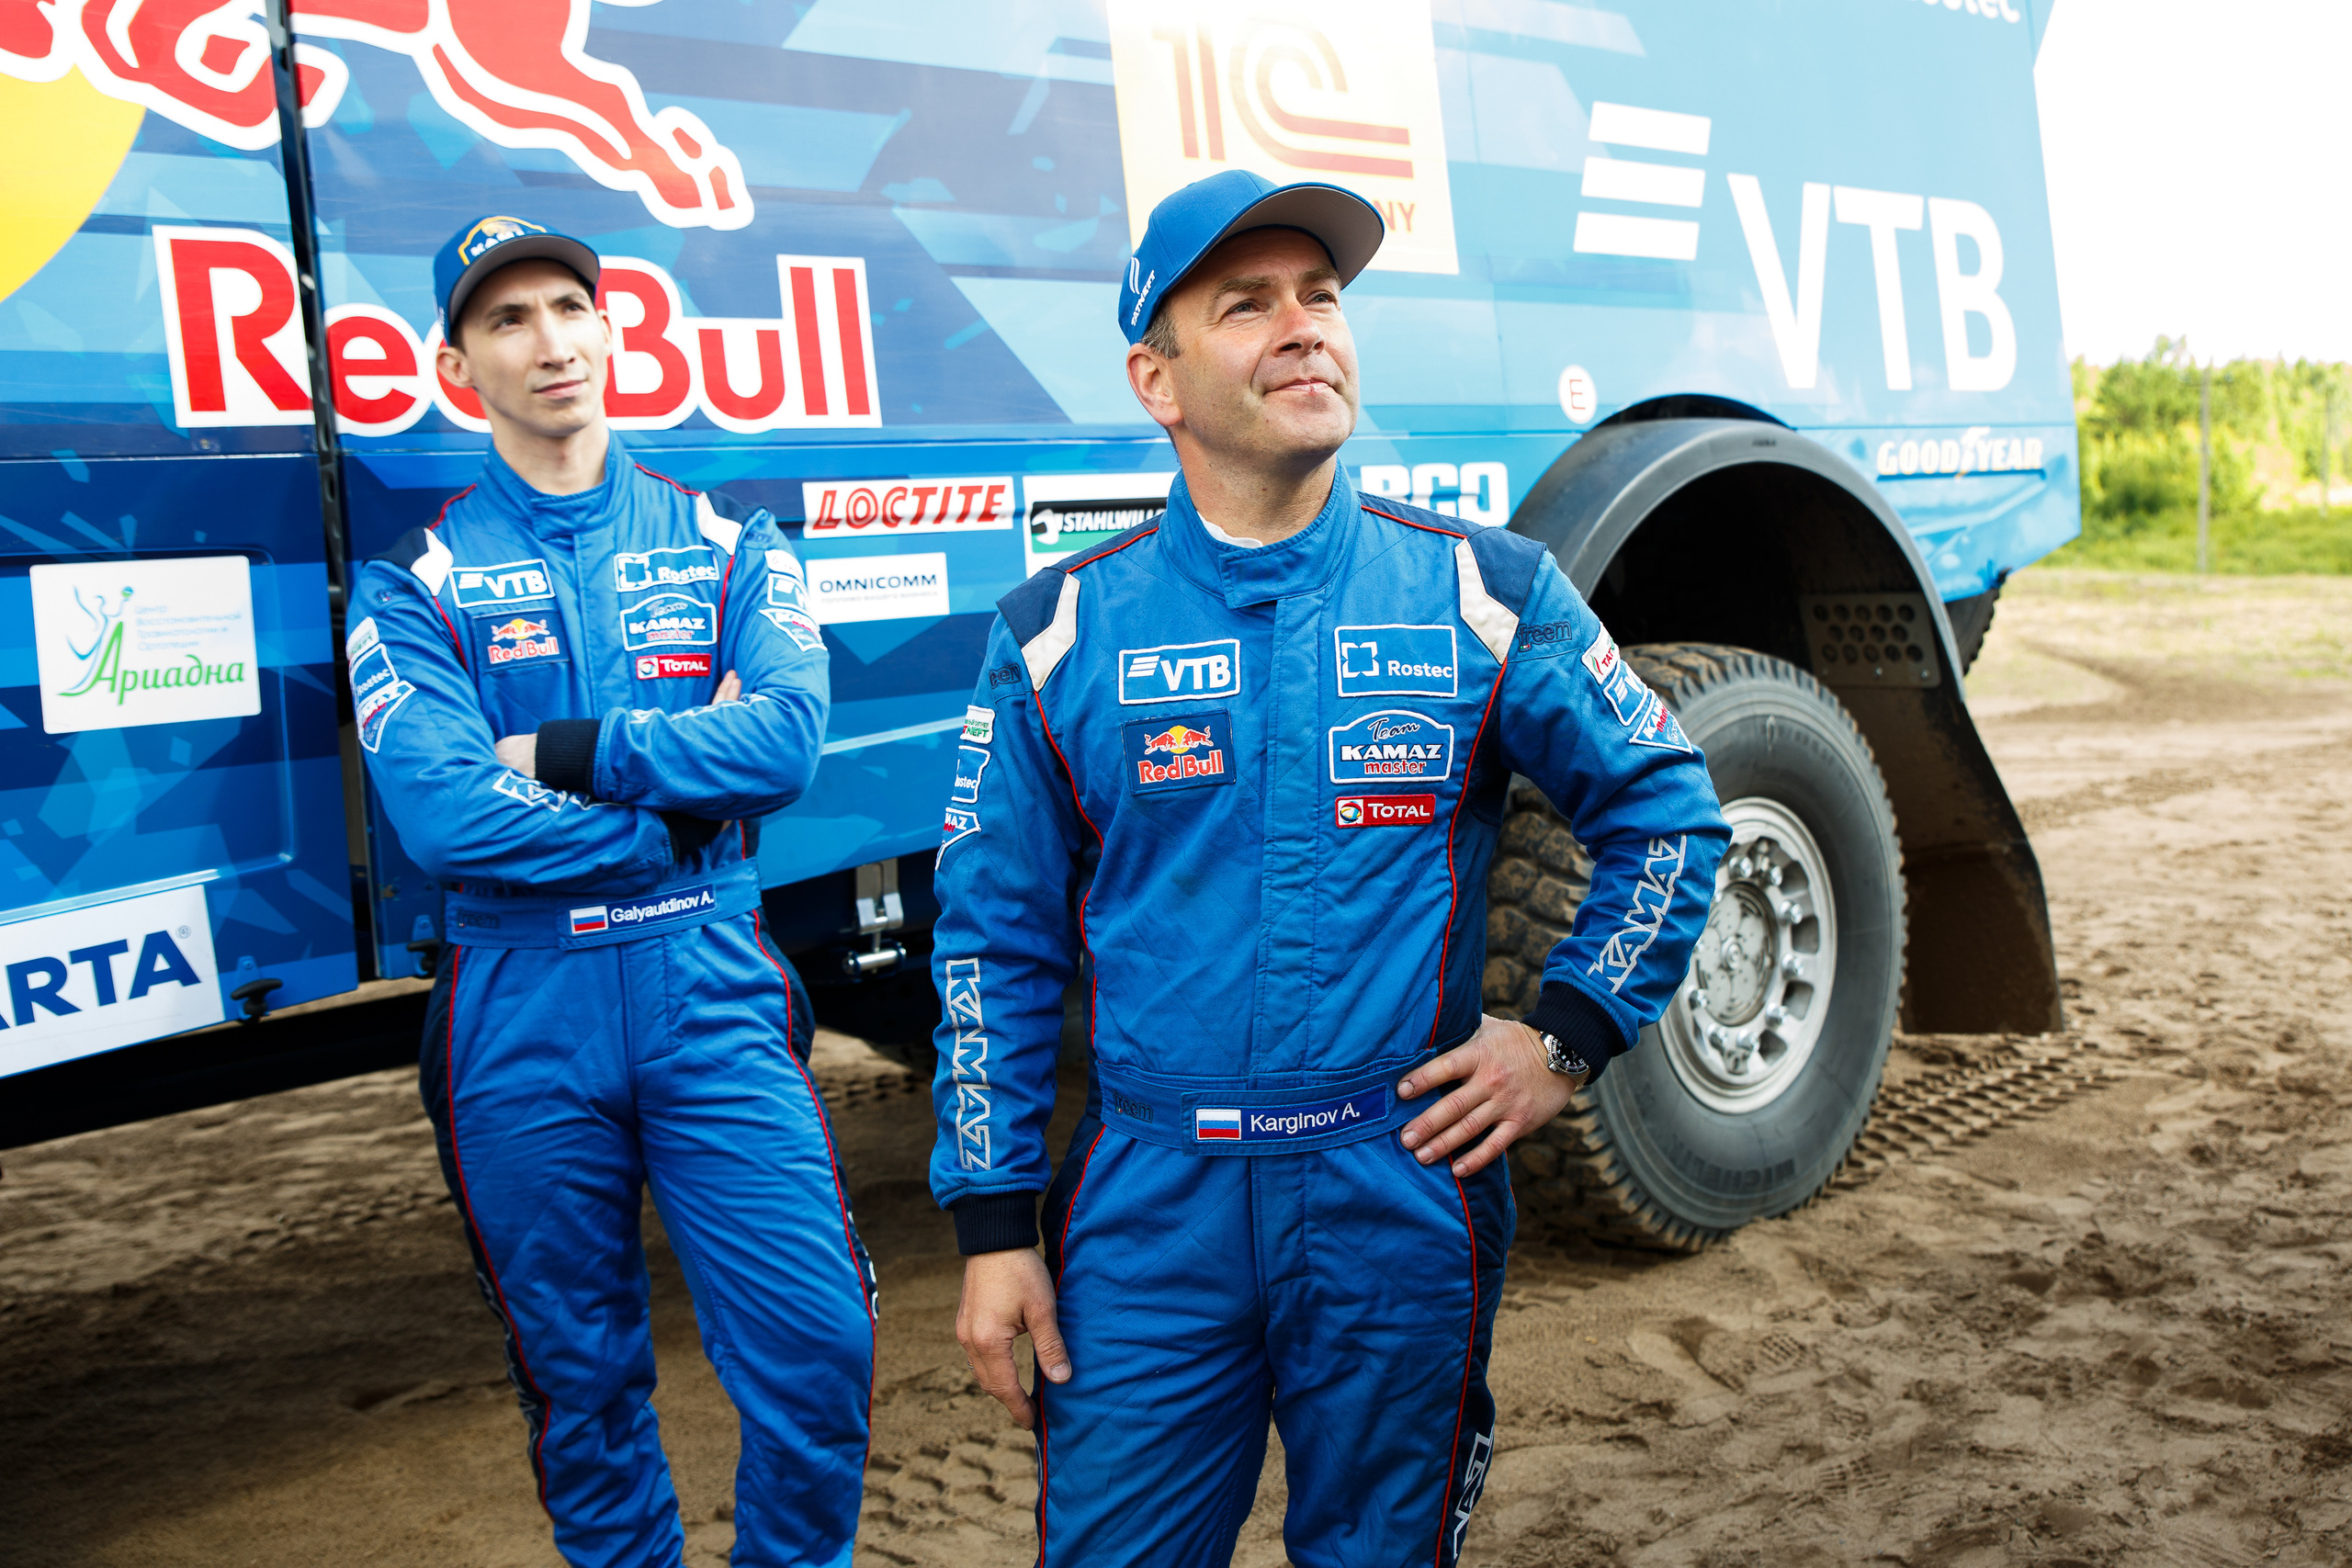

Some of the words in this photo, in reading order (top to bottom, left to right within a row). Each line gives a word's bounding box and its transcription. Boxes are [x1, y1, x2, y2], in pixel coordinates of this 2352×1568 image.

[1726, 172, 2018, 392] VTB
[169, 237, 492, 426] Re
[593, 265, 871, 421] Bull
[1568, 378, 1587, 411] E
[1877, 425, 2043, 477] GOODYEAR
[812, 484, 1007, 531] LOCTITE
[483, 570, 548, 598] VTB
[657, 565, 717, 581] Rostec
[820, 574, 938, 594] OMNICOMM
[628, 616, 707, 635] KAMAZ
[1517, 620, 1573, 649] freem
[57, 621, 245, 706] Ариадна
[487, 640, 524, 664] Red
[524, 636, 560, 658] Bull
[660, 658, 708, 673] TOTAL
[1159, 654, 1231, 692] VTB
[1387, 660, 1453, 679] Rostec
[1367, 717, 1421, 742] Team
[1137, 755, 1182, 784] Red
[1182, 749, 1225, 778] Bull
[1340, 743, 1445, 762] KAMAZ
[1363, 759, 1427, 775] master
[1367, 802, 1430, 818] TOTAL
[610, 897, 700, 923] Galyautdinov
[700, 890, 715, 907] A.
[0, 930, 202, 1031] RTA
[945, 957, 991, 1172] KAMAZ
[1250, 1109, 1338, 1135] Karginov
[1340, 1101, 1361, 1120] A.
